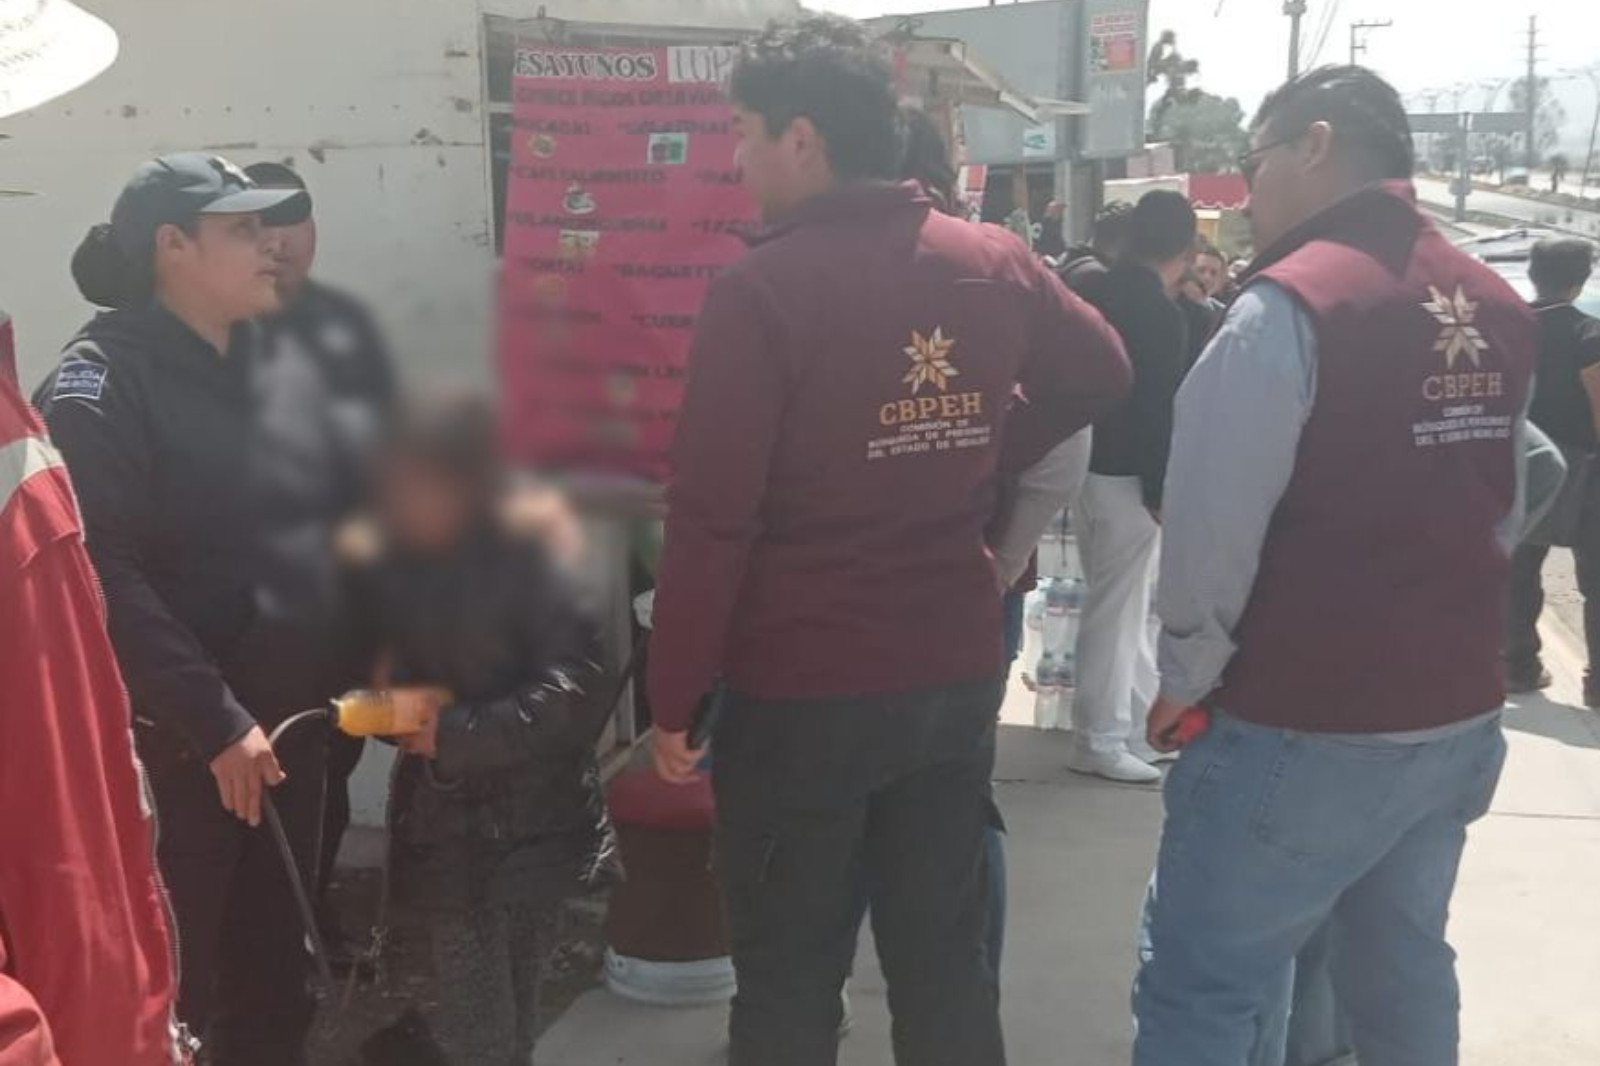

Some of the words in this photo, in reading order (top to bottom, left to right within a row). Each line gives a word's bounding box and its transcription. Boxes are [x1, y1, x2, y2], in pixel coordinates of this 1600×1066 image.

[675, 48, 732, 81] LUP
[1422, 372, 1503, 401] CBPEH
[879, 392, 982, 425] CBPEH
